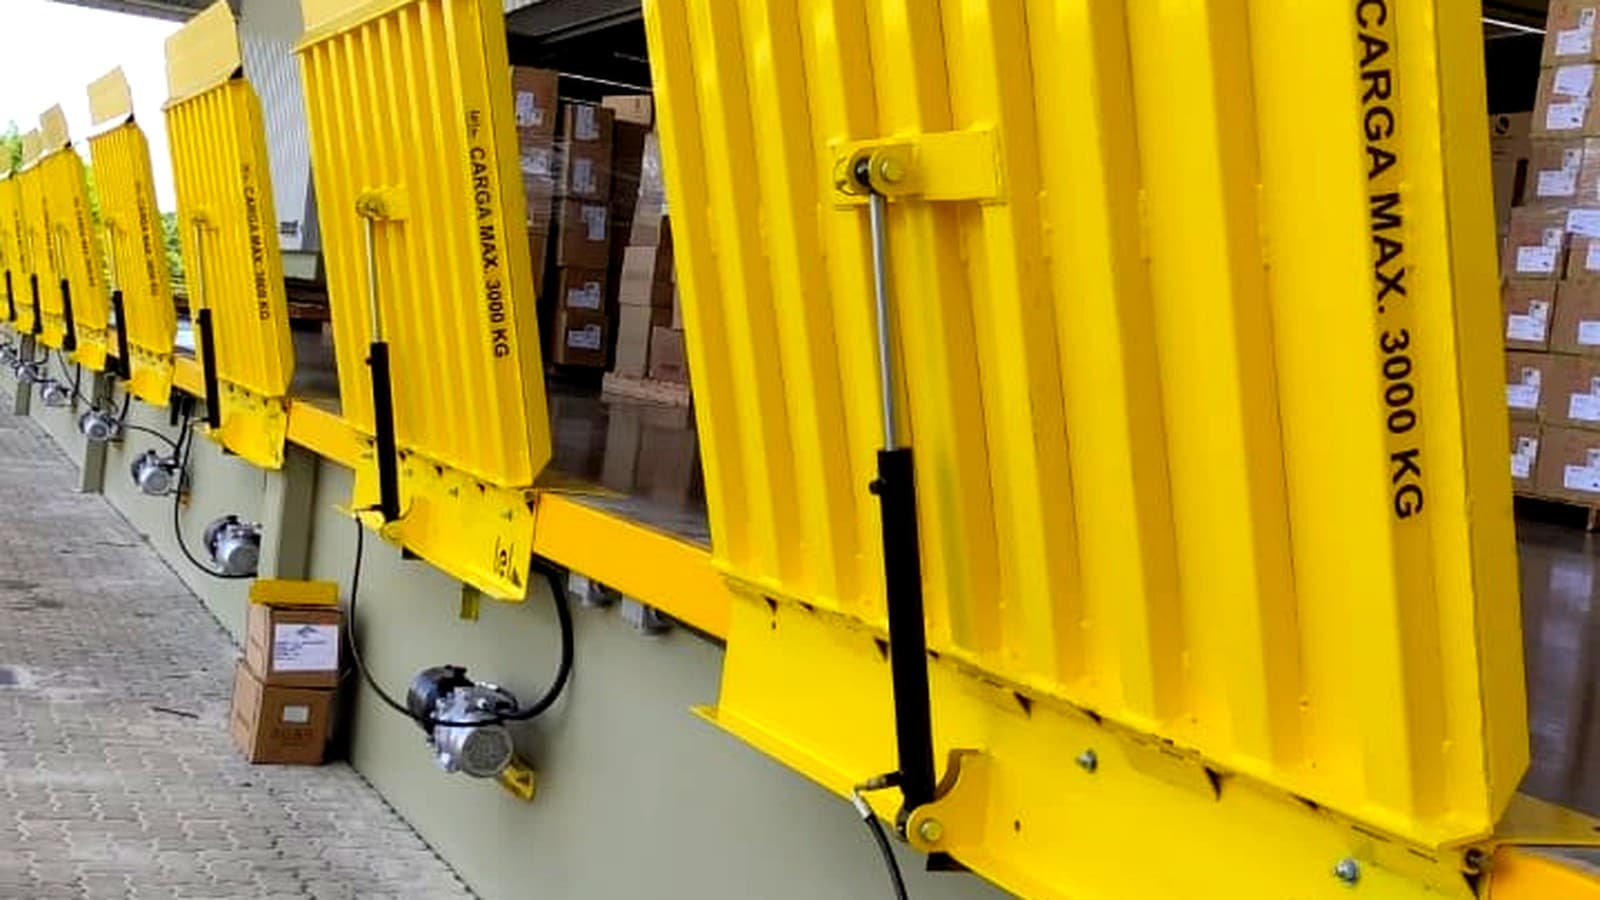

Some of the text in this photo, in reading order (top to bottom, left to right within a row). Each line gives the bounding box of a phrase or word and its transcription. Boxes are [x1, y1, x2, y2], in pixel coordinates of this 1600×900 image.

[469, 146, 493, 218] CARGA
[1355, 0, 1424, 520] CARGA MAX. 3000 KG
[485, 279, 506, 324] 3000
[491, 328, 510, 359] KG
